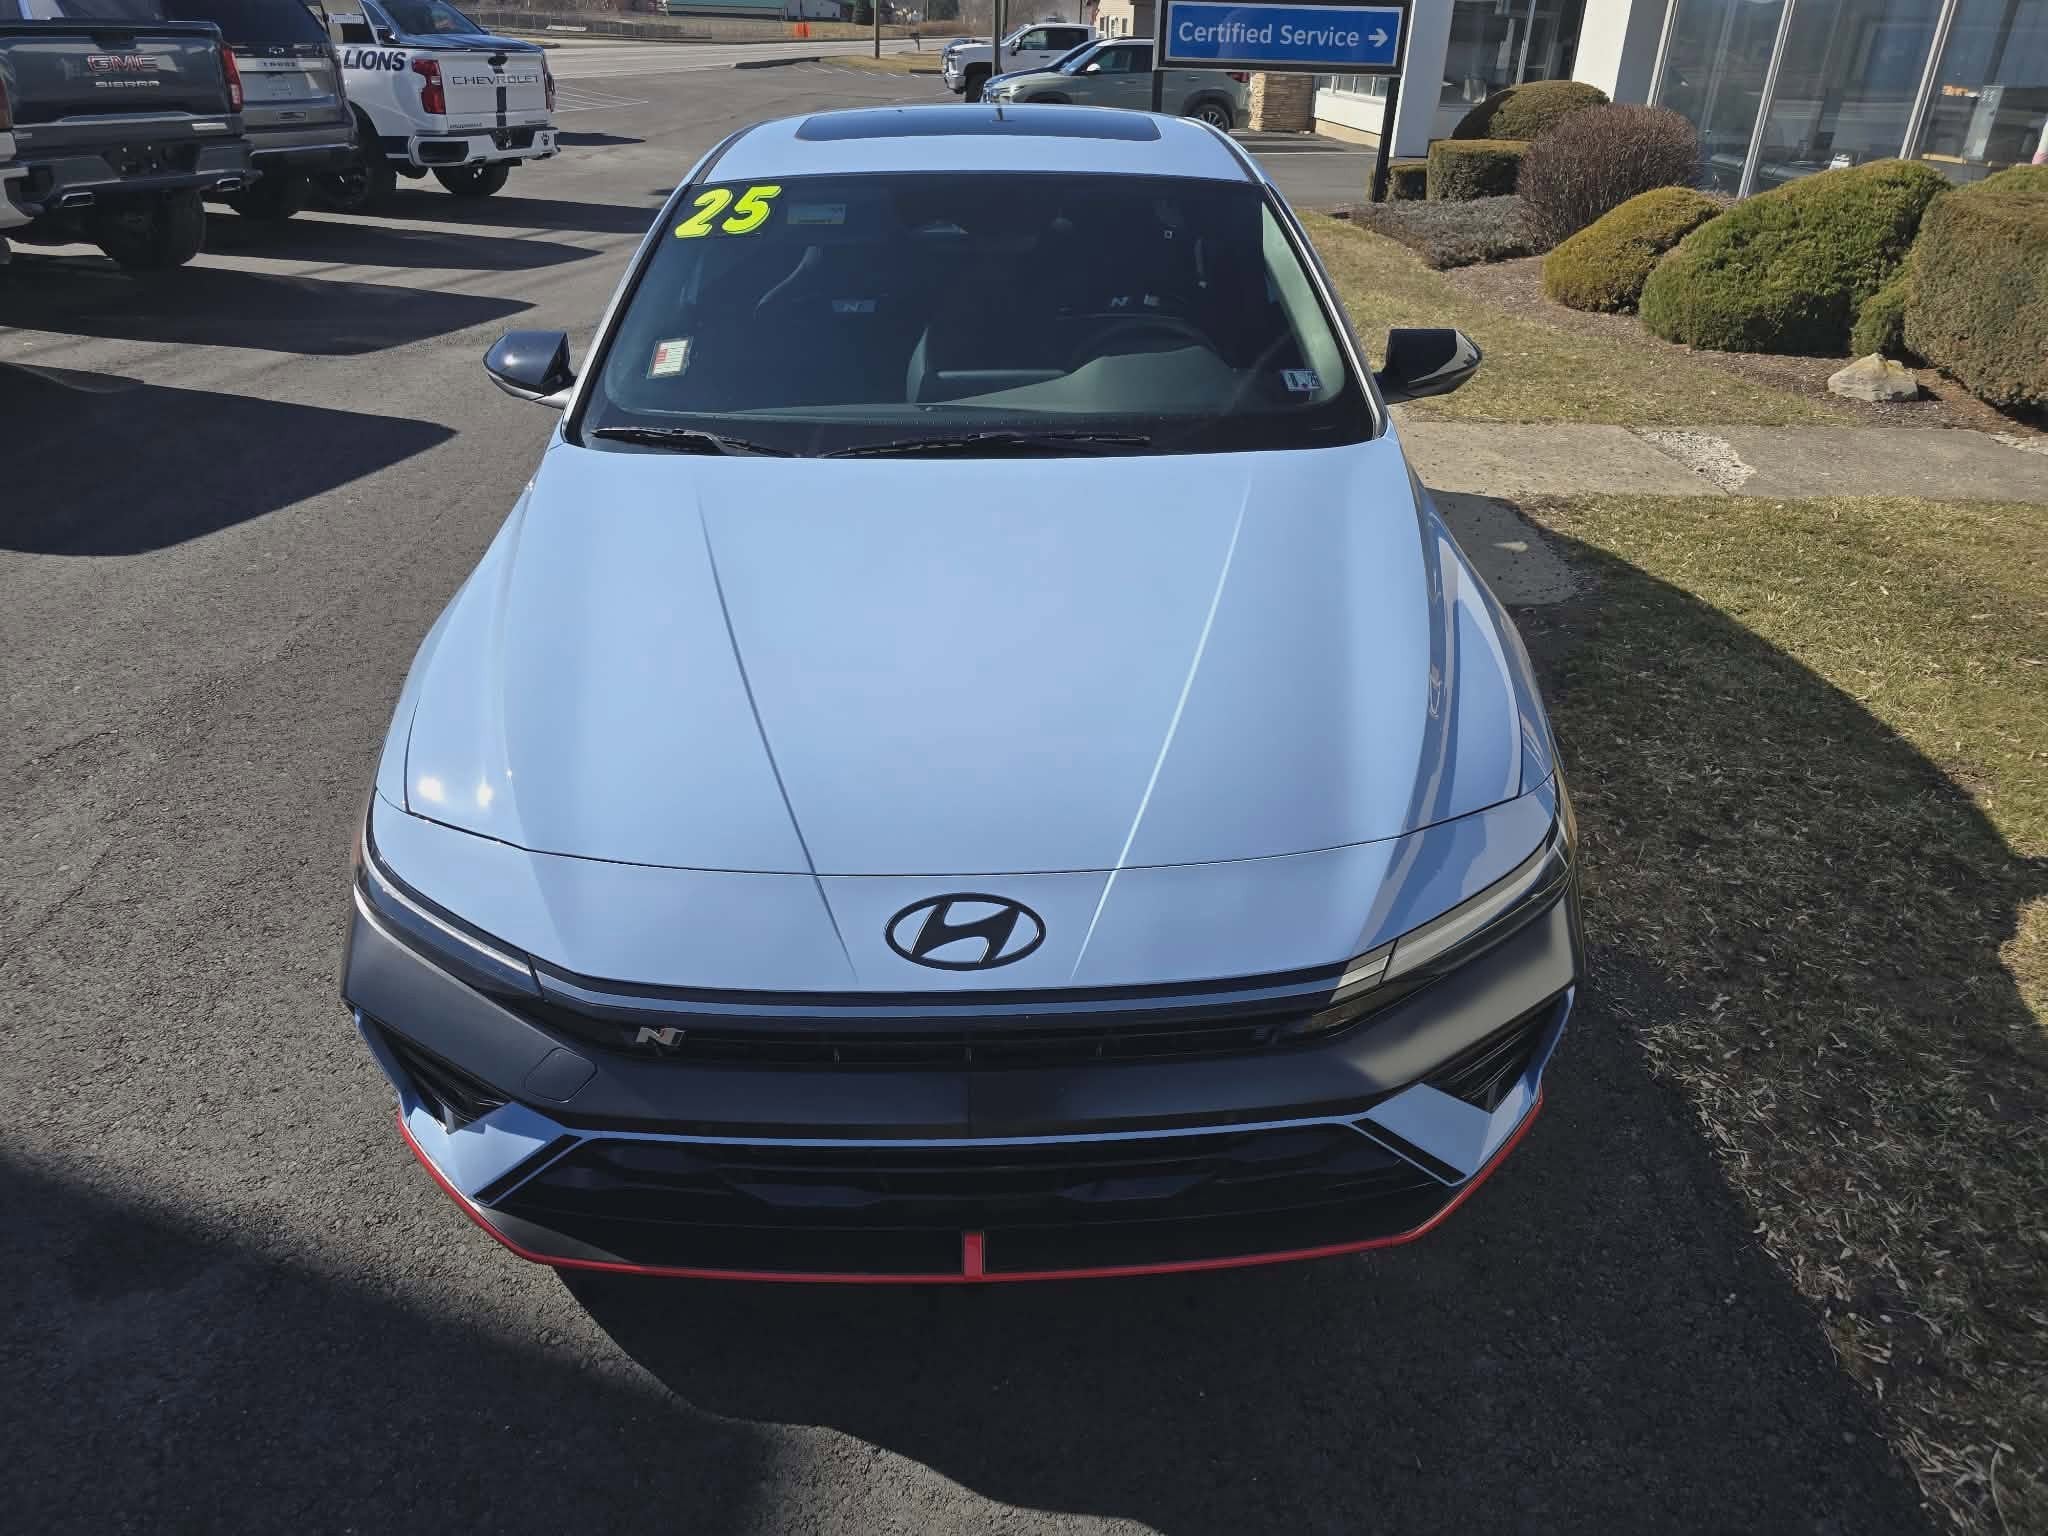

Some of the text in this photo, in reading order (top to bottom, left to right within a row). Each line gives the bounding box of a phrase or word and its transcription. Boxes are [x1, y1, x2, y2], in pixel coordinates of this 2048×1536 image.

[1179, 22, 1359, 46] Certified Service
[88, 55, 159, 72] GMC
[343, 50, 407, 71] LIONS
[452, 75, 538, 85] CHEVROLET
[674, 185, 783, 239] 25
